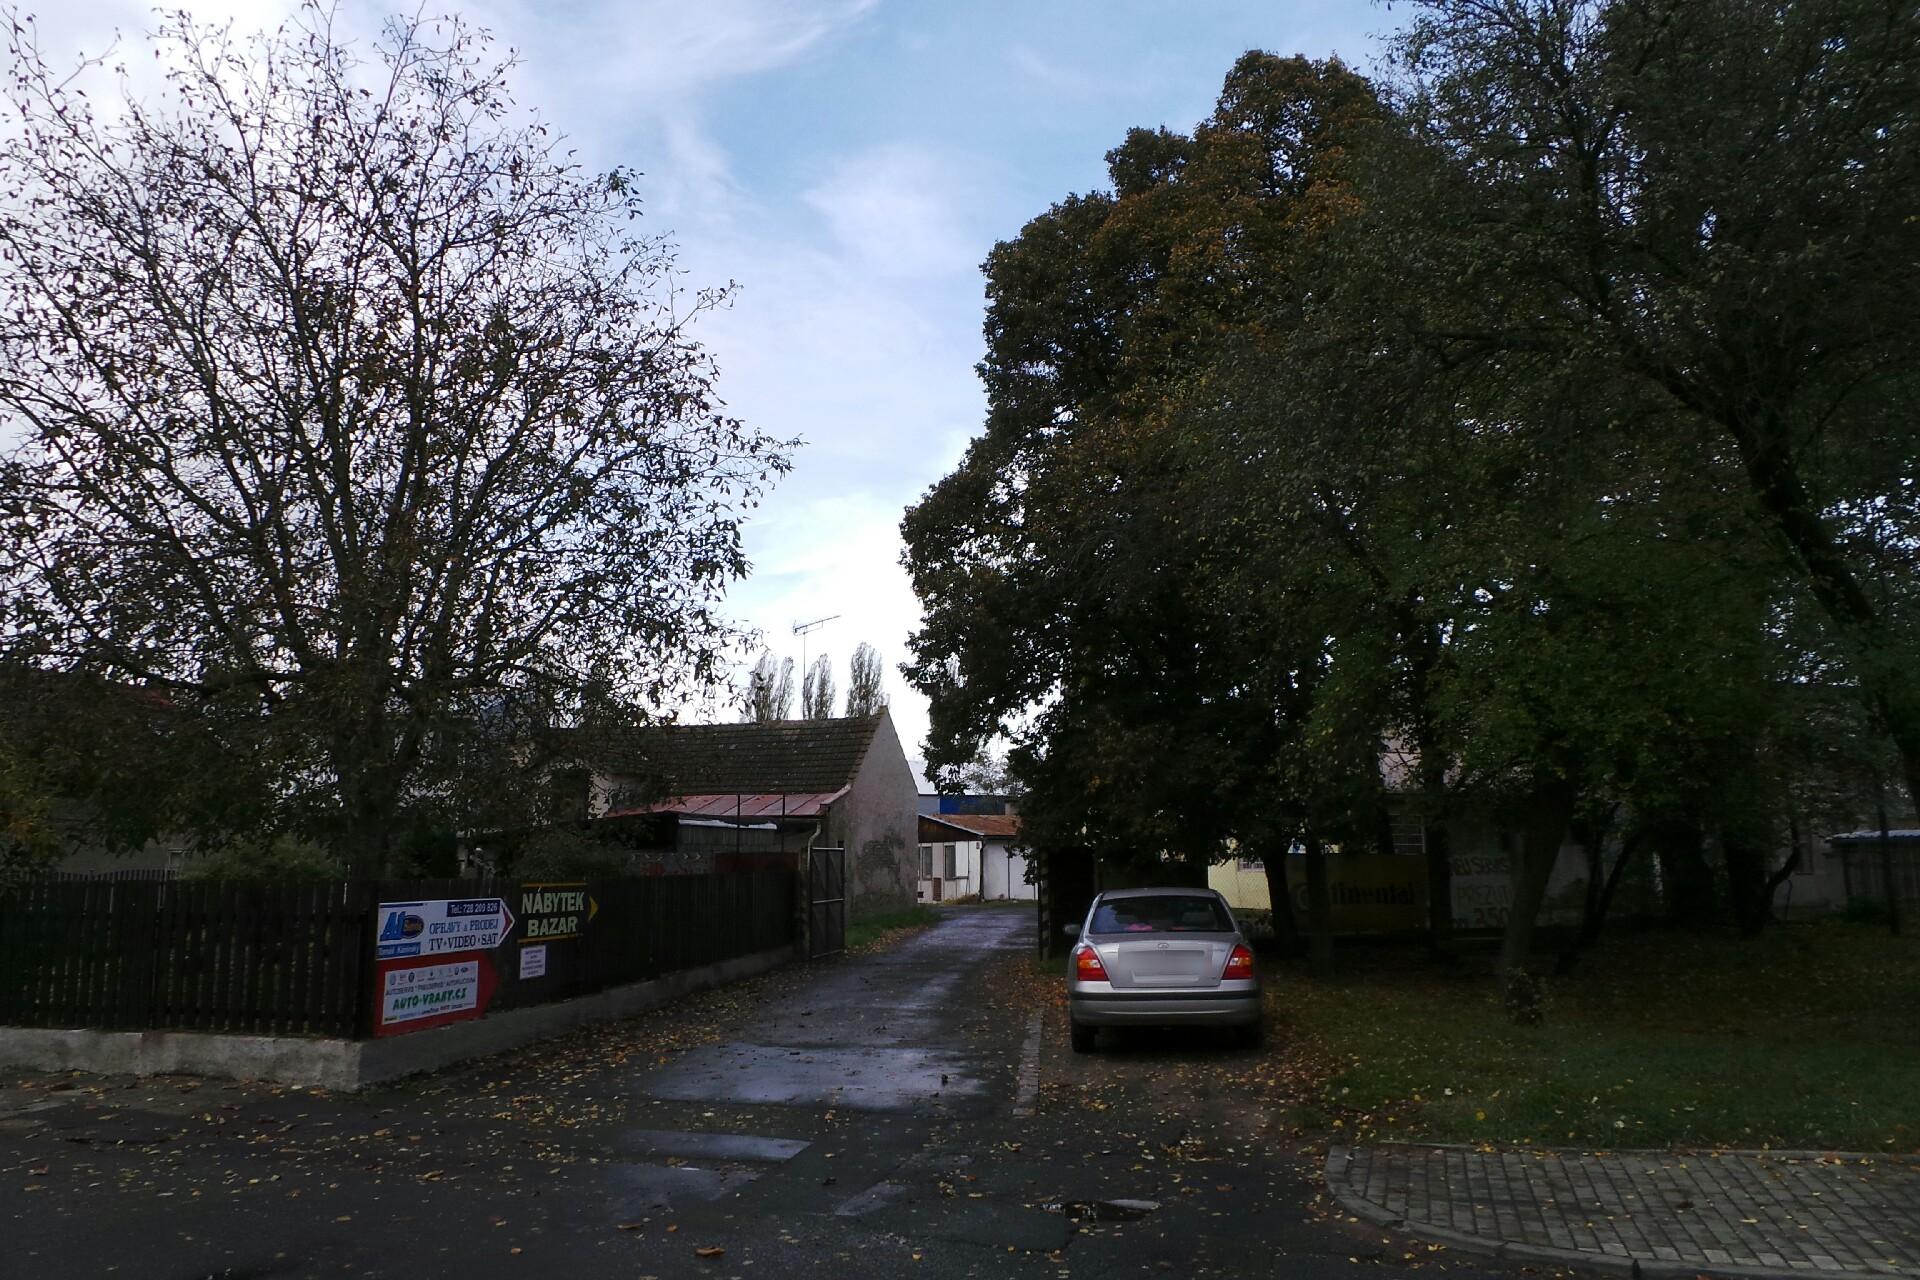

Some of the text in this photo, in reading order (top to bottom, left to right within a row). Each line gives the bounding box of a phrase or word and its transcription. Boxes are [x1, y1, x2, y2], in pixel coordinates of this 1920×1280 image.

[521, 887, 585, 914] NÁBYTEK
[1293, 881, 1415, 911] Ctinental
[429, 921, 461, 934] OPRAVY
[470, 918, 498, 931] PRODEJ
[527, 916, 578, 939] BAZAR
[429, 938, 444, 951] TV
[448, 935, 476, 949] VIDEO
[481, 933, 499, 946] SAT
